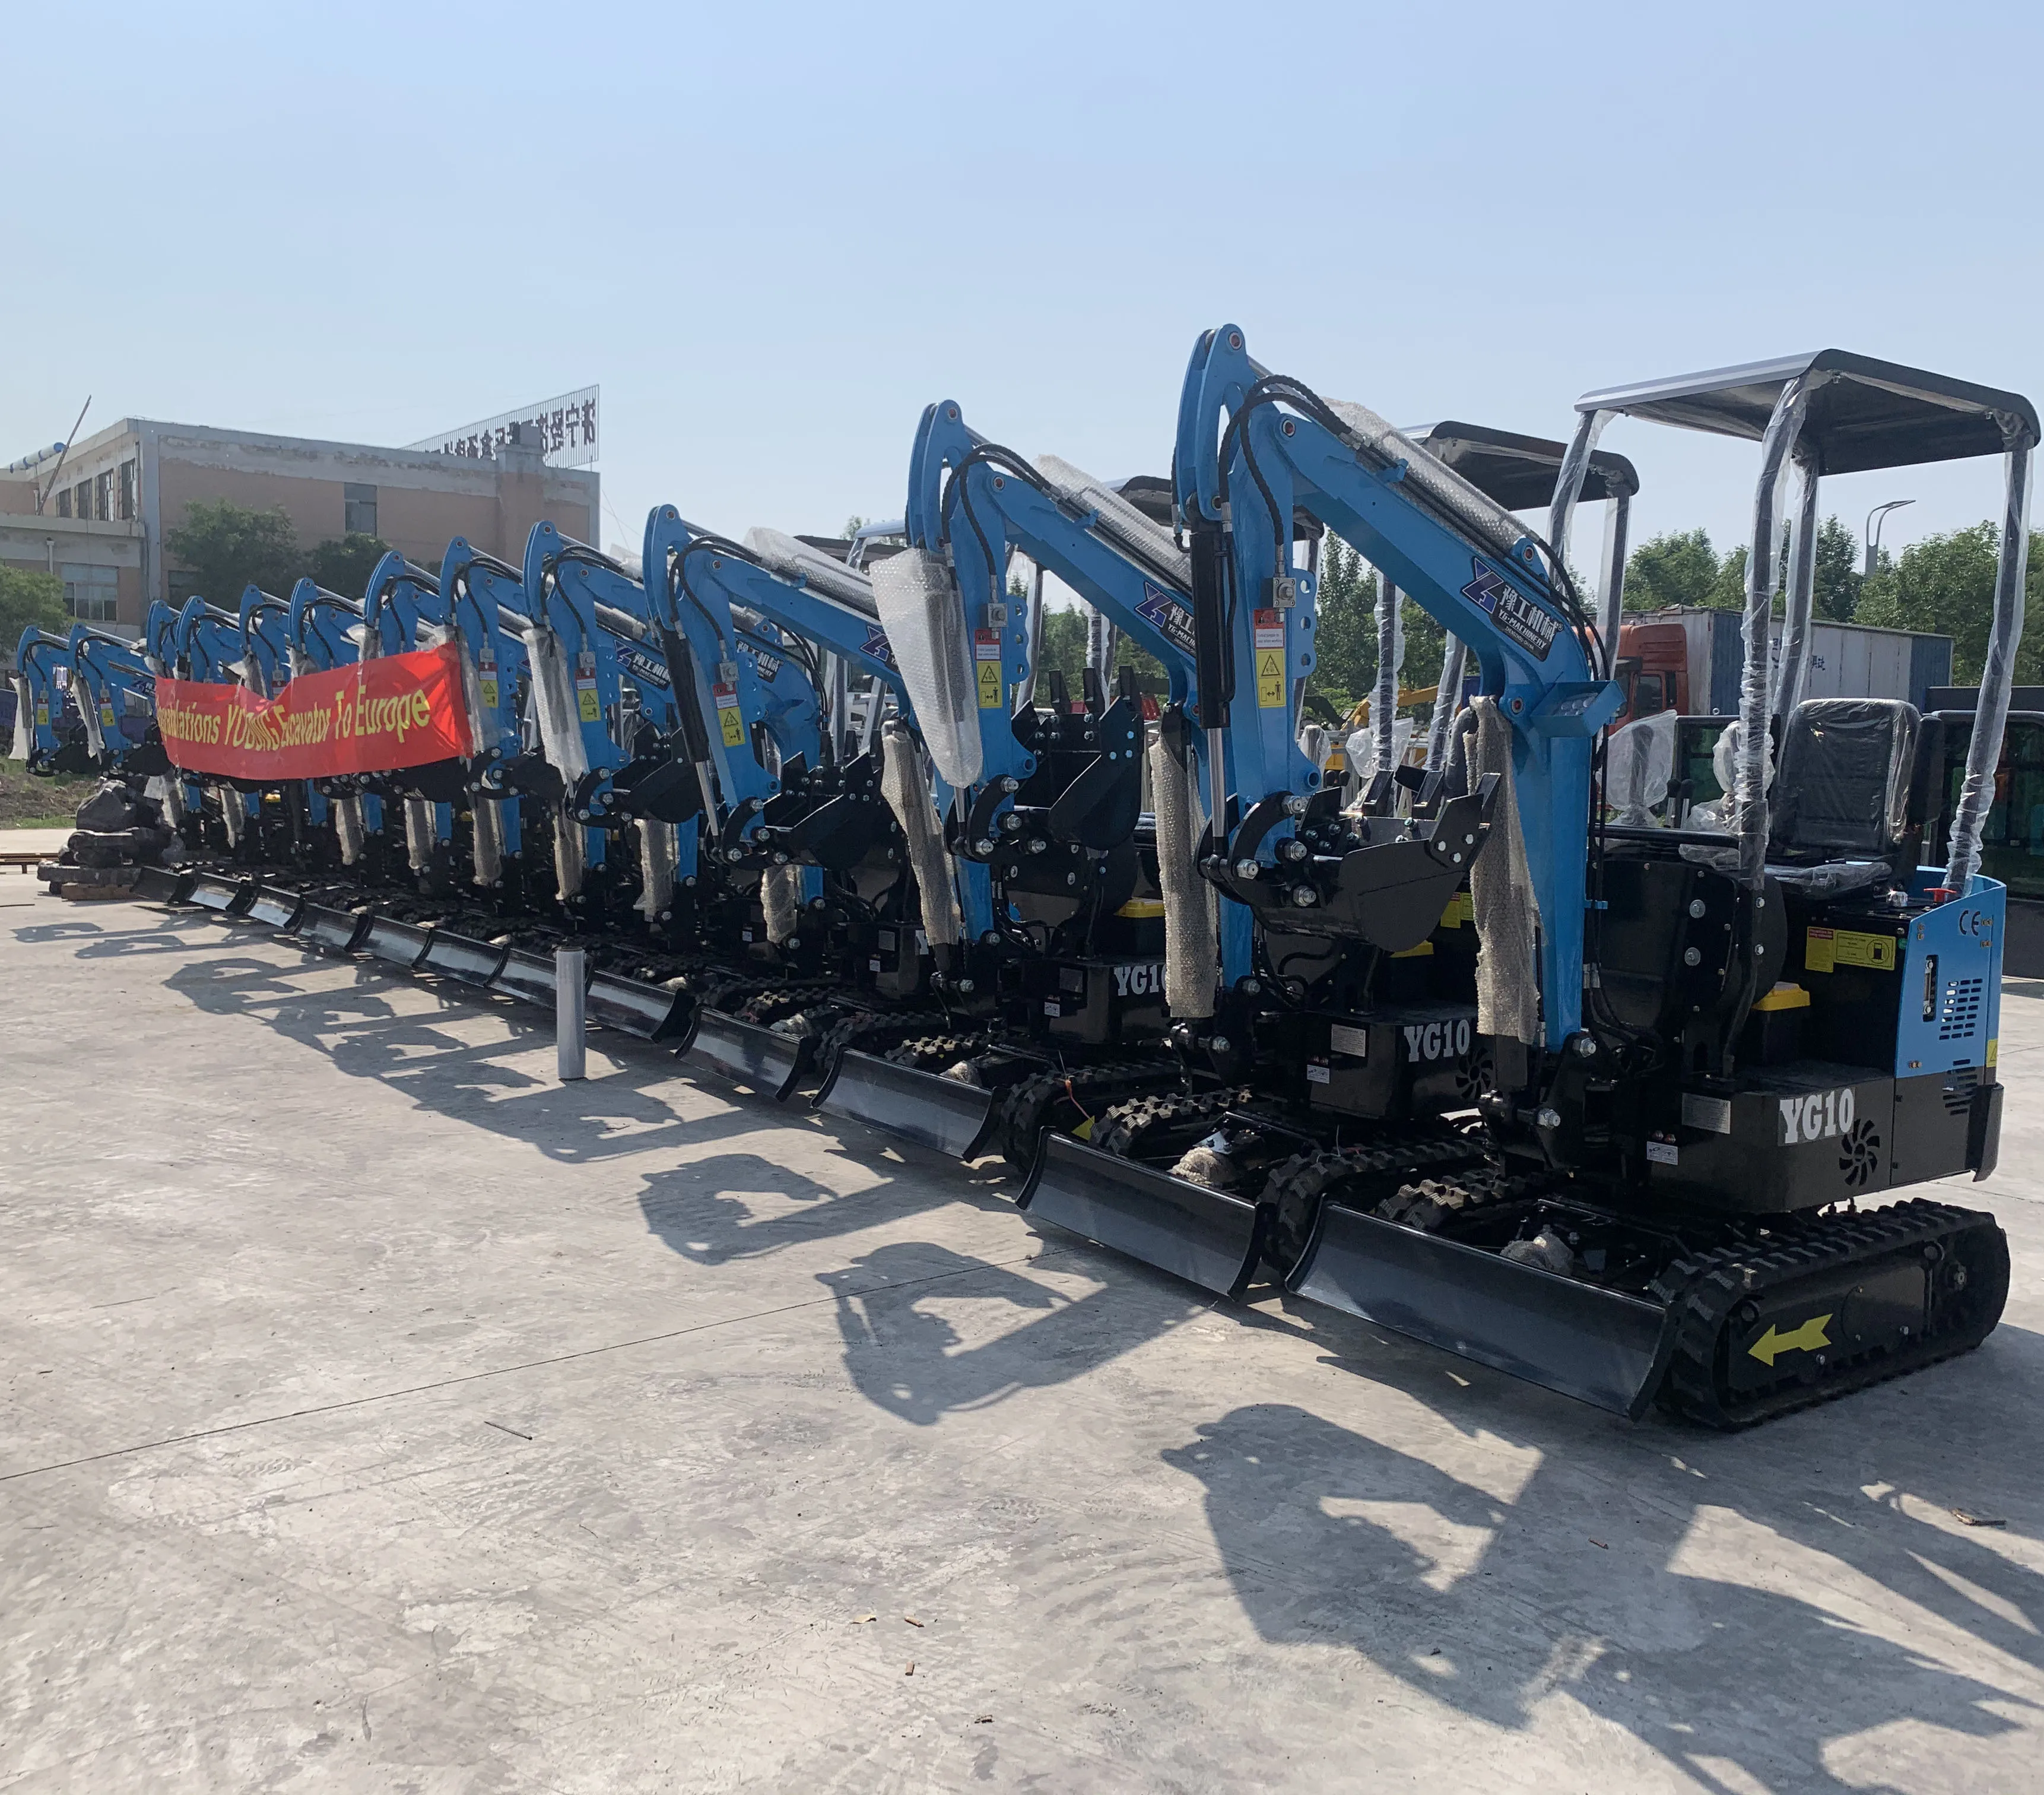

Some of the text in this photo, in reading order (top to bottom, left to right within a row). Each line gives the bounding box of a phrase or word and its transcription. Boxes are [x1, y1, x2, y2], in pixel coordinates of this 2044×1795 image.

[1499, 584, 1559, 642] 豫工机械
[274, 702, 331, 747] Excavator
[335, 690, 352, 740] To
[355, 684, 430, 743] Europe
[1960, 910, 1980, 936] CE
[1404, 1019, 1470, 1062] YG10
[1780, 1088, 1855, 1143] YG10
